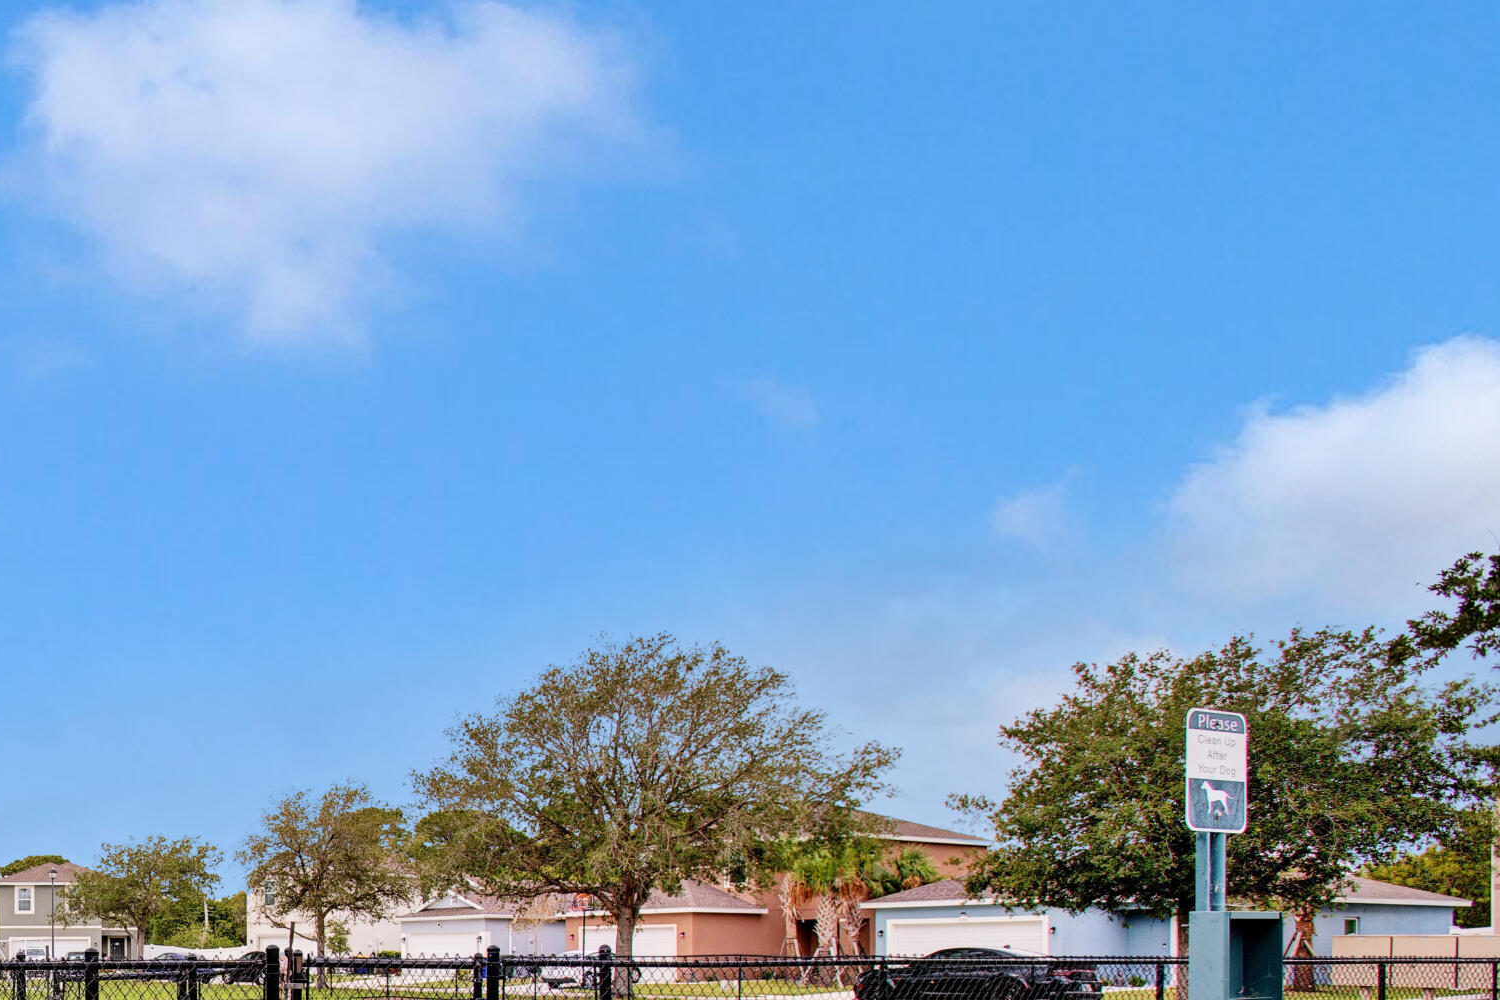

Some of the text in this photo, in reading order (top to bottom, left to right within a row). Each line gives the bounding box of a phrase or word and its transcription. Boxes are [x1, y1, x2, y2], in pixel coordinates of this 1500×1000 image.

[1198, 713, 1238, 731] Please
[1197, 734, 1236, 747] Clean Up
[1206, 750, 1228, 760] After
[1197, 763, 1236, 777] Your Dog
